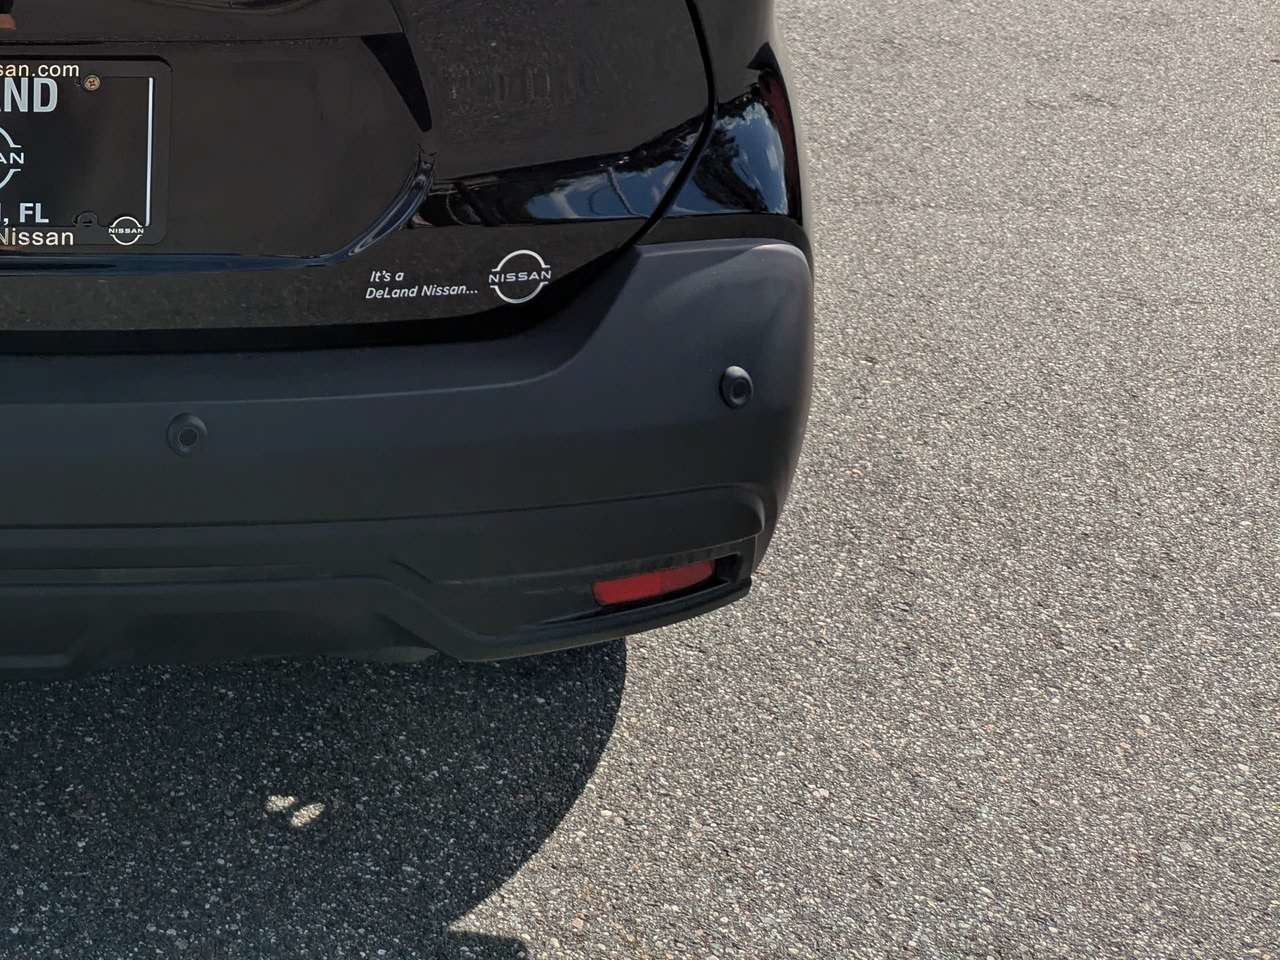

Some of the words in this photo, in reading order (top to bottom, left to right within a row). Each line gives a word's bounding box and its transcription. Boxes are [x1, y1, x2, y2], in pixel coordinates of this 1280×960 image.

[19, 202, 50, 224] FL
[108, 227, 145, 235] NISSAN
[370, 270, 392, 283] It's
[395, 272, 405, 282] a
[488, 270, 552, 284] NISSAN
[365, 285, 418, 300] DeLand
[420, 284, 479, 297] Nissan...
